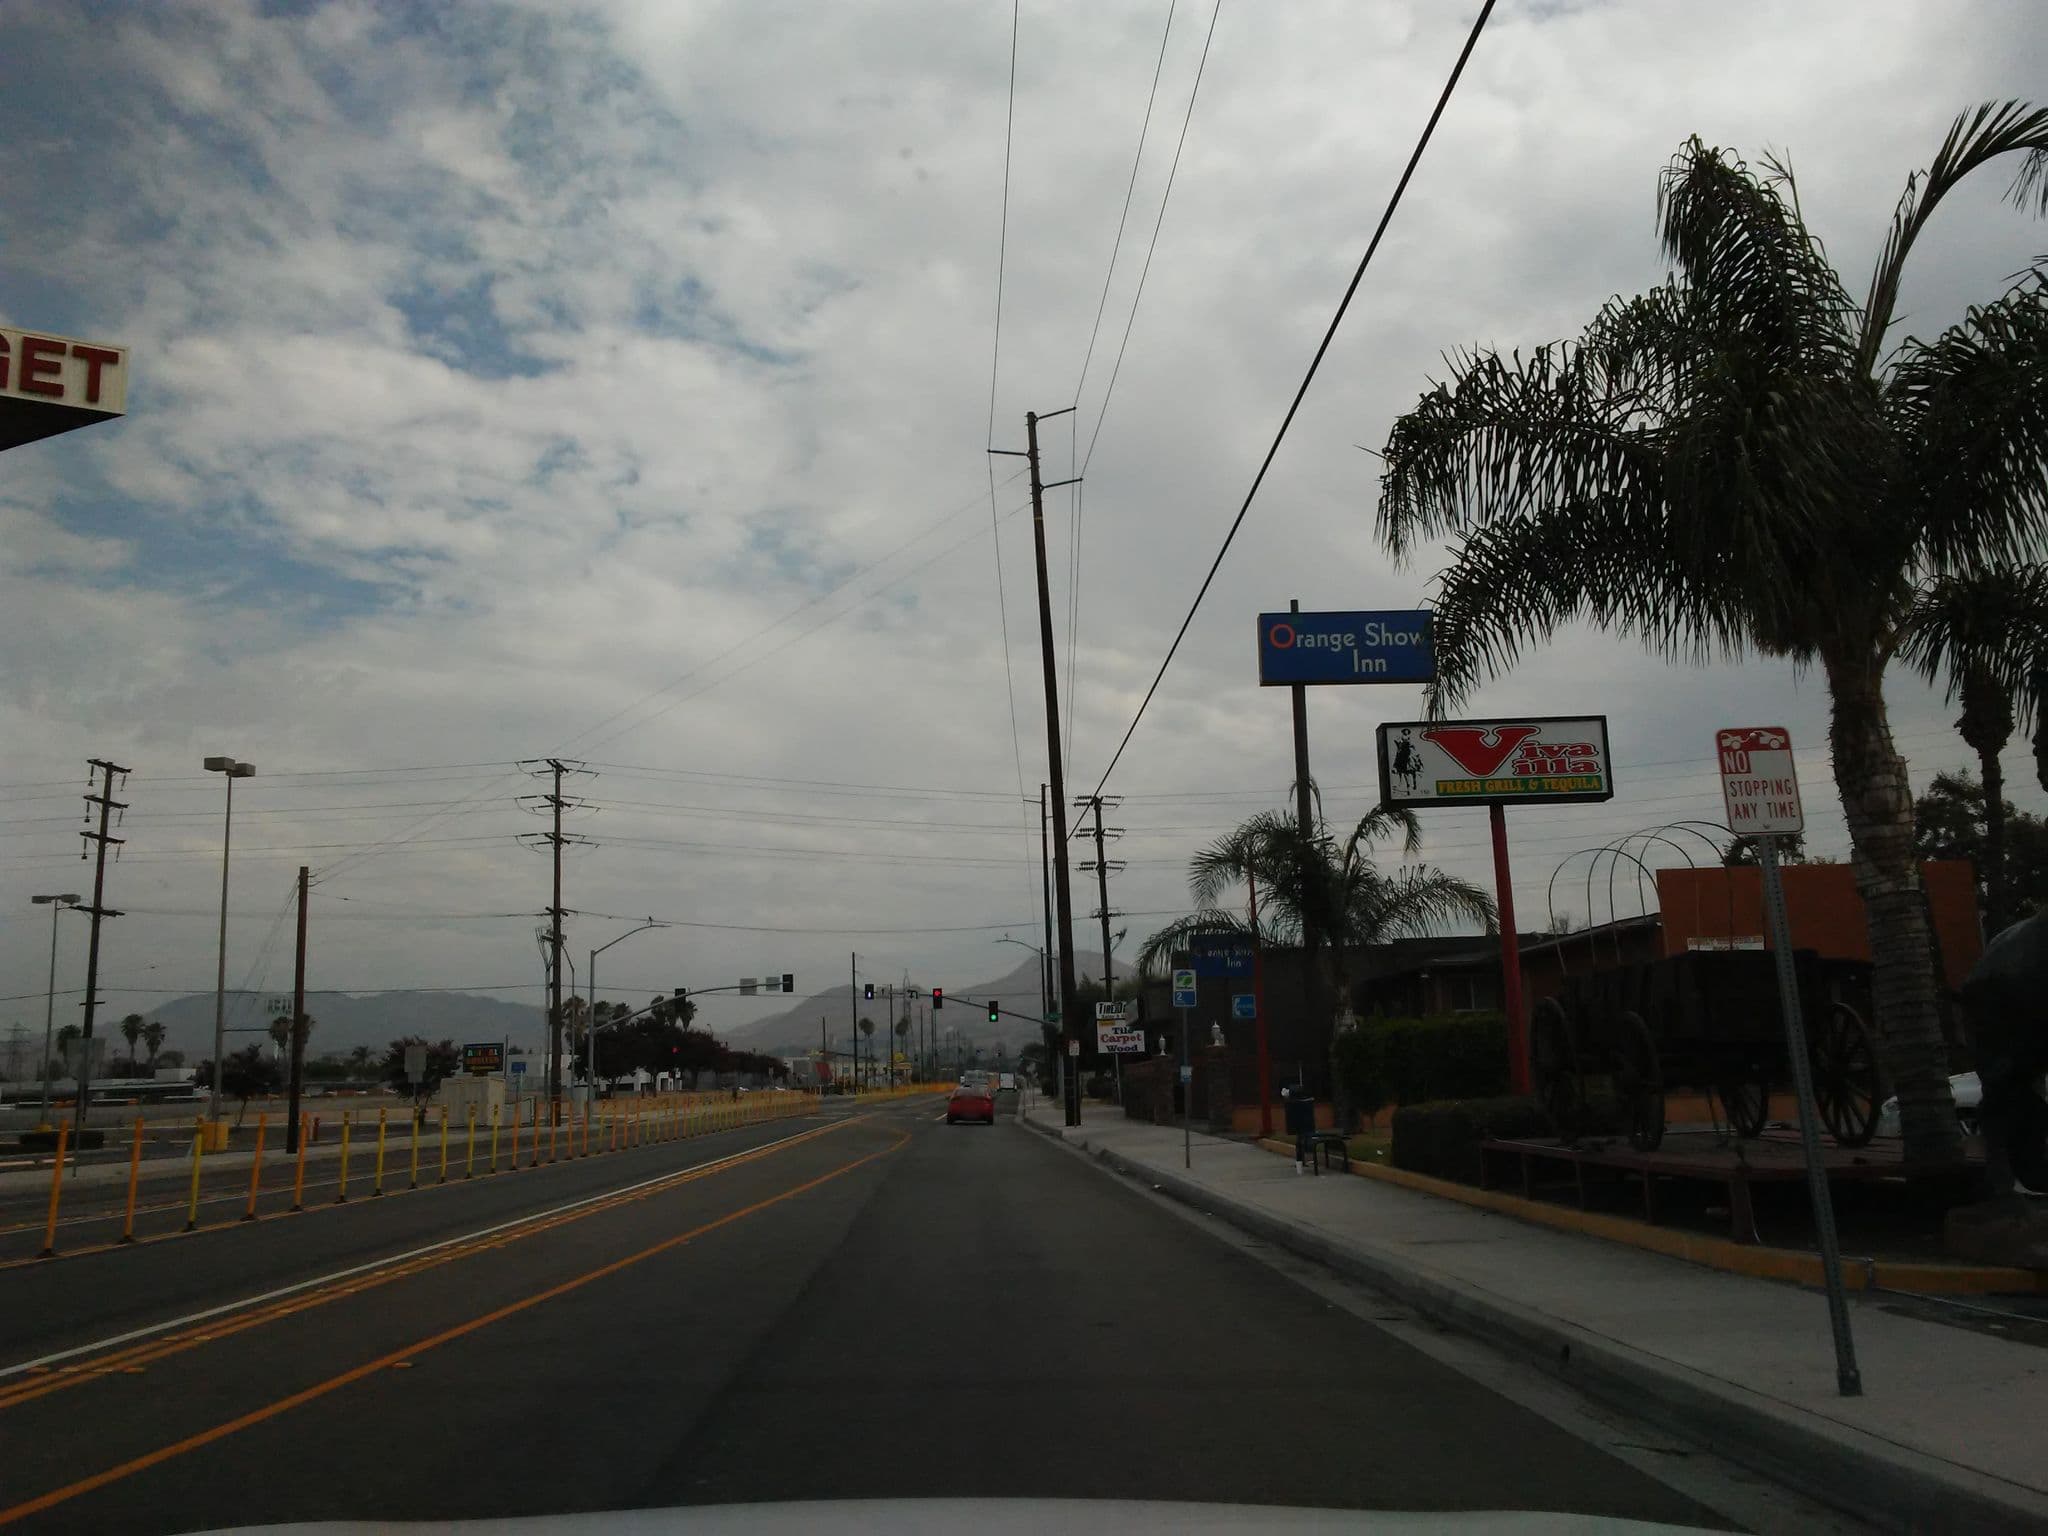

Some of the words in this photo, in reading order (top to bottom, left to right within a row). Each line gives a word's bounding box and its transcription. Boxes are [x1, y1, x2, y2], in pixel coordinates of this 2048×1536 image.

[0, 333, 119, 402] ET
[1269, 623, 1356, 653] Orange
[1364, 621, 1425, 647] Show
[1352, 648, 1388, 674] Inn
[1723, 751, 1749, 774] NO
[1438, 781, 1482, 795] FRESH
[1484, 780, 1523, 793] GRILL
[1539, 777, 1601, 792] TEQUILA
[1729, 779, 1793, 798] STOPPING
[1734, 803, 1758, 820] ANY
[1766, 802, 1797, 819] TIME
[1176, 992, 1183, 1001] 2
[1100, 1033, 1143, 1045] Carpet
[1106, 1044, 1138, 1052] Wood
